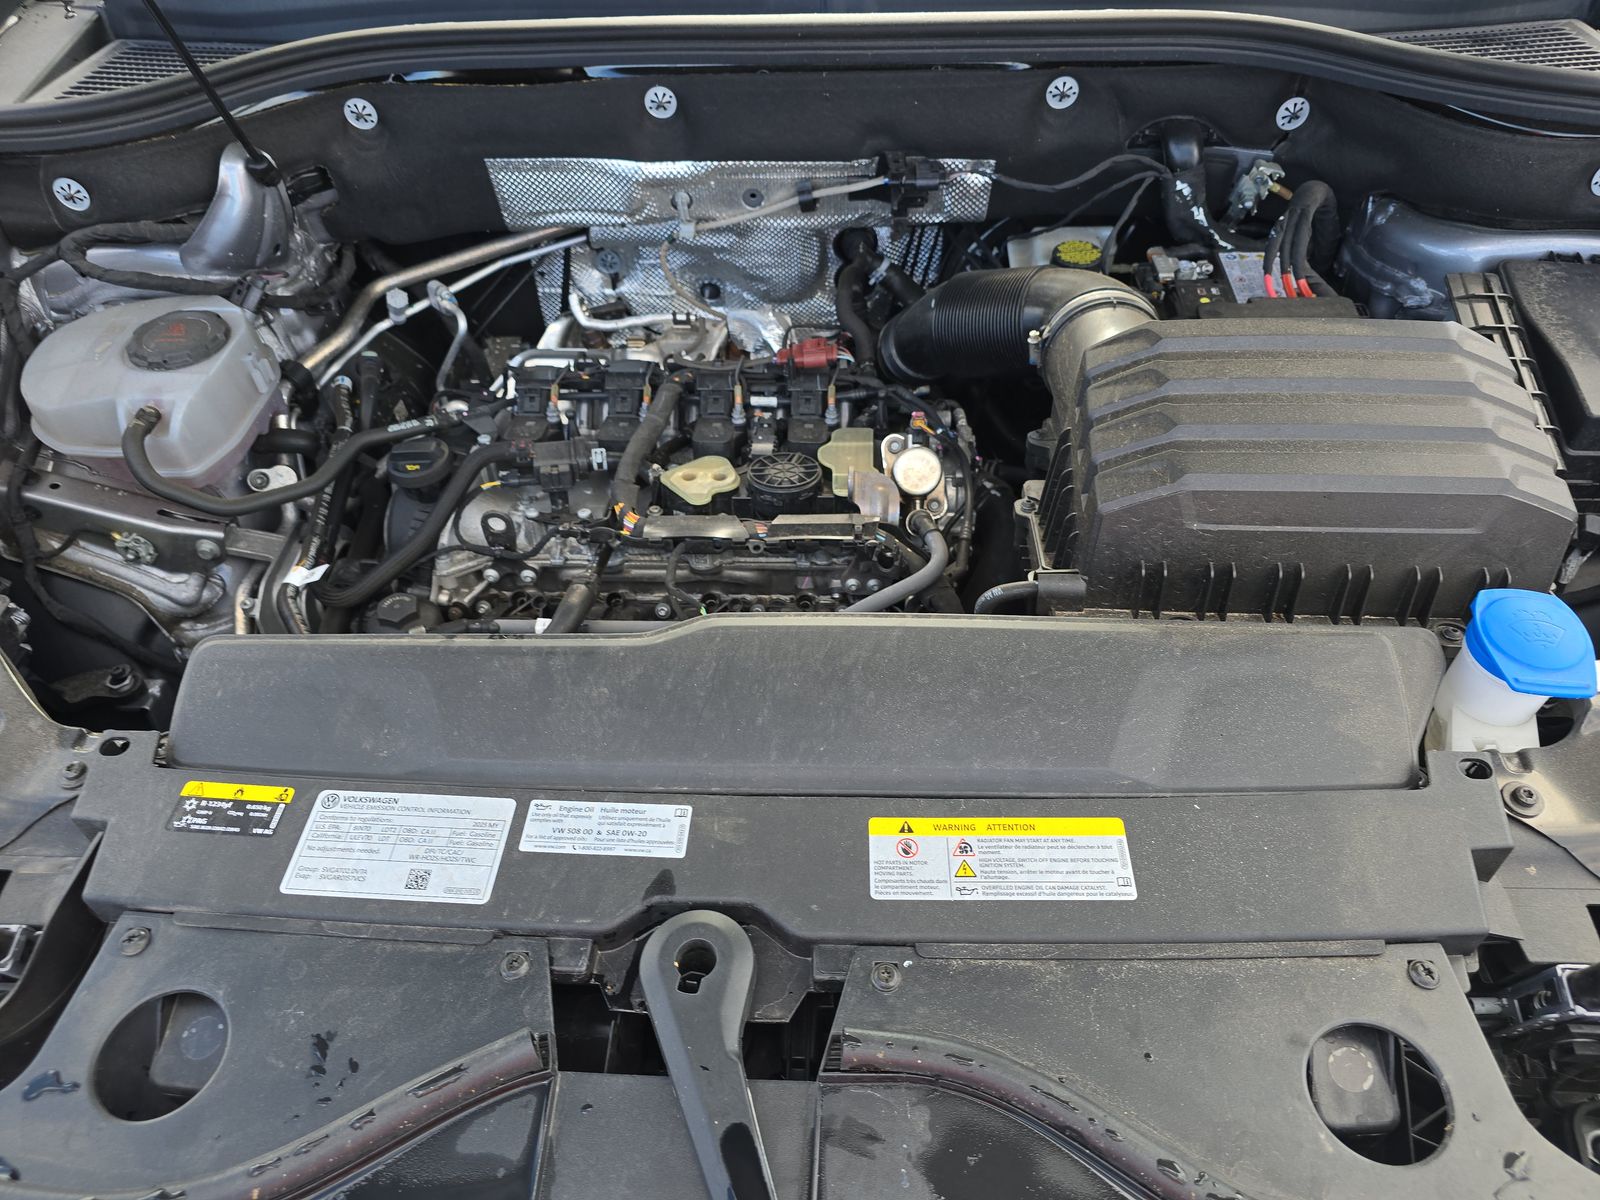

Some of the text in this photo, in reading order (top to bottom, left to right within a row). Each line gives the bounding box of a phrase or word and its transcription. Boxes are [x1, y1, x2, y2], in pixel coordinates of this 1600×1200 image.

[343, 796, 399, 804] VOLKSWAGEN
[427, 807, 472, 815] INFORMATION
[559, 806, 583, 814] Engine
[933, 824, 1036, 832] WARNING ATTENTION
[469, 830, 497, 838] Gasoline
[316, 846, 355, 854] adjustments
